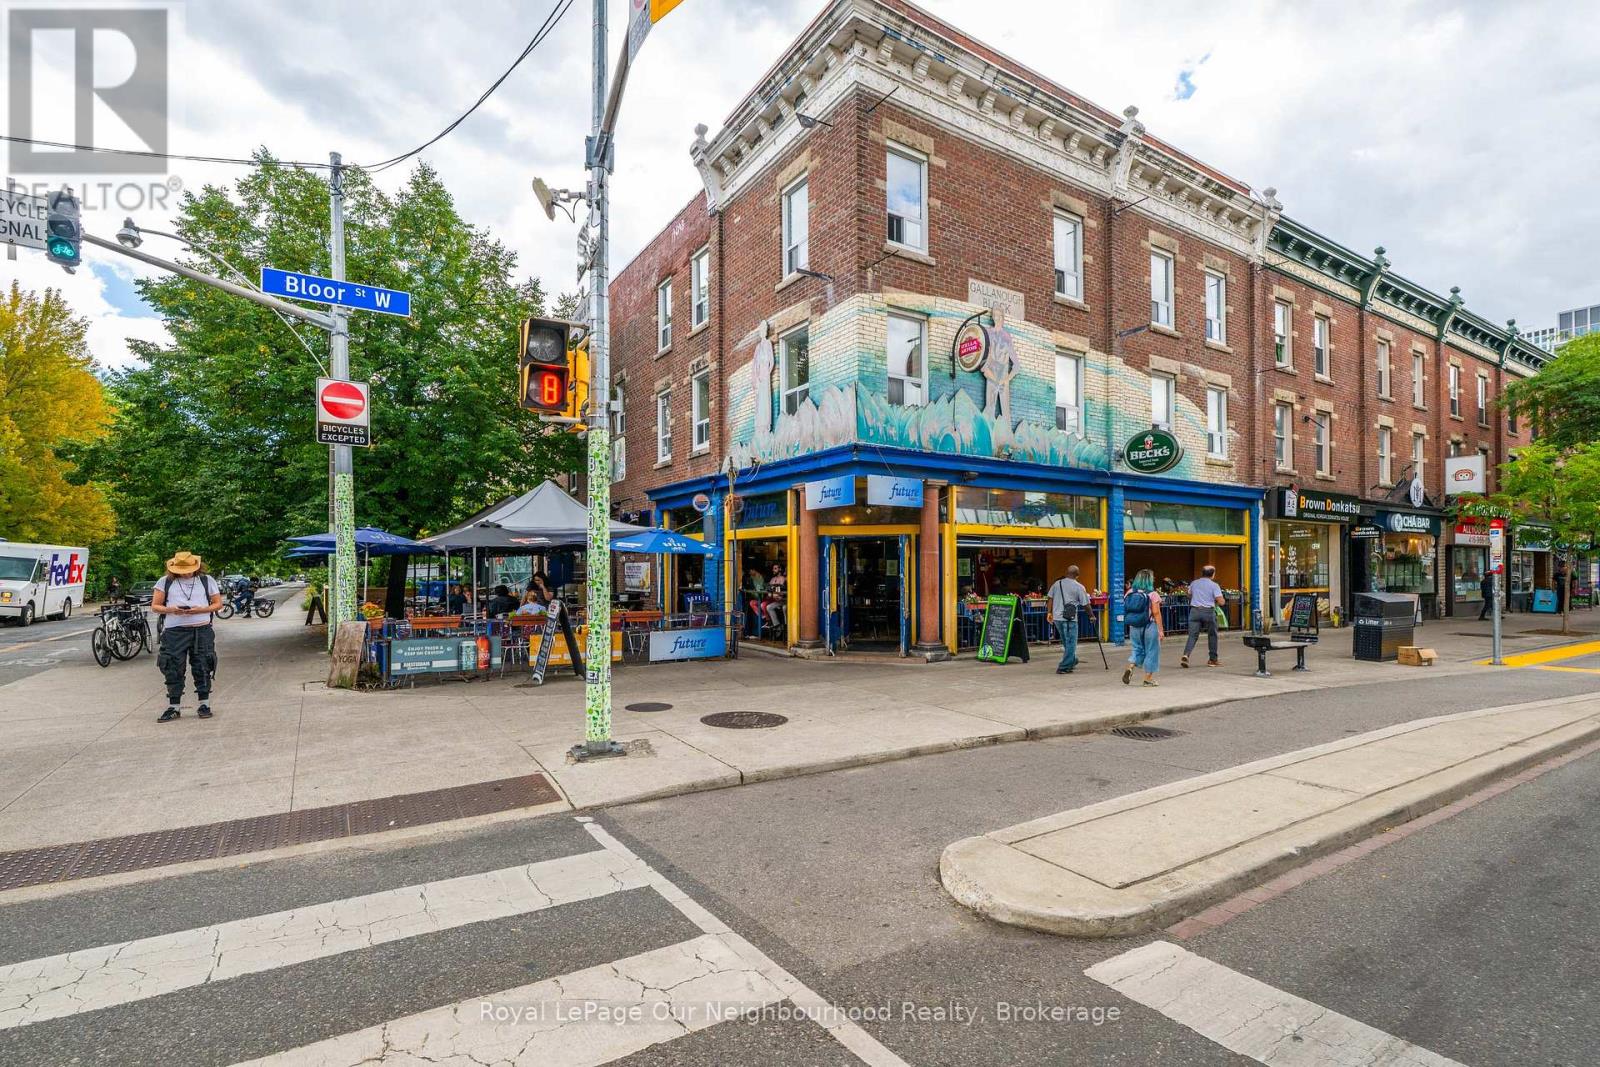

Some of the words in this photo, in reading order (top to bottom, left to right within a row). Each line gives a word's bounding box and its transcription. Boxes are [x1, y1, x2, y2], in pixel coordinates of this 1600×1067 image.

[285, 275, 346, 301] Bloor
[355, 287, 366, 298] St
[374, 291, 391, 309] W
[544, 374, 557, 404] 8
[321, 433, 366, 444] EXCEPTED
[323, 424, 364, 435] BICYCLES
[819, 485, 842, 503] future
[889, 482, 920, 500] future
[1300, 495, 1325, 511] Brown
[1326, 498, 1361, 514] Donkatsu
[49, 553, 85, 586] FedEx
[1365, 618, 1380, 626] Litter
[671, 636, 708, 654] future
